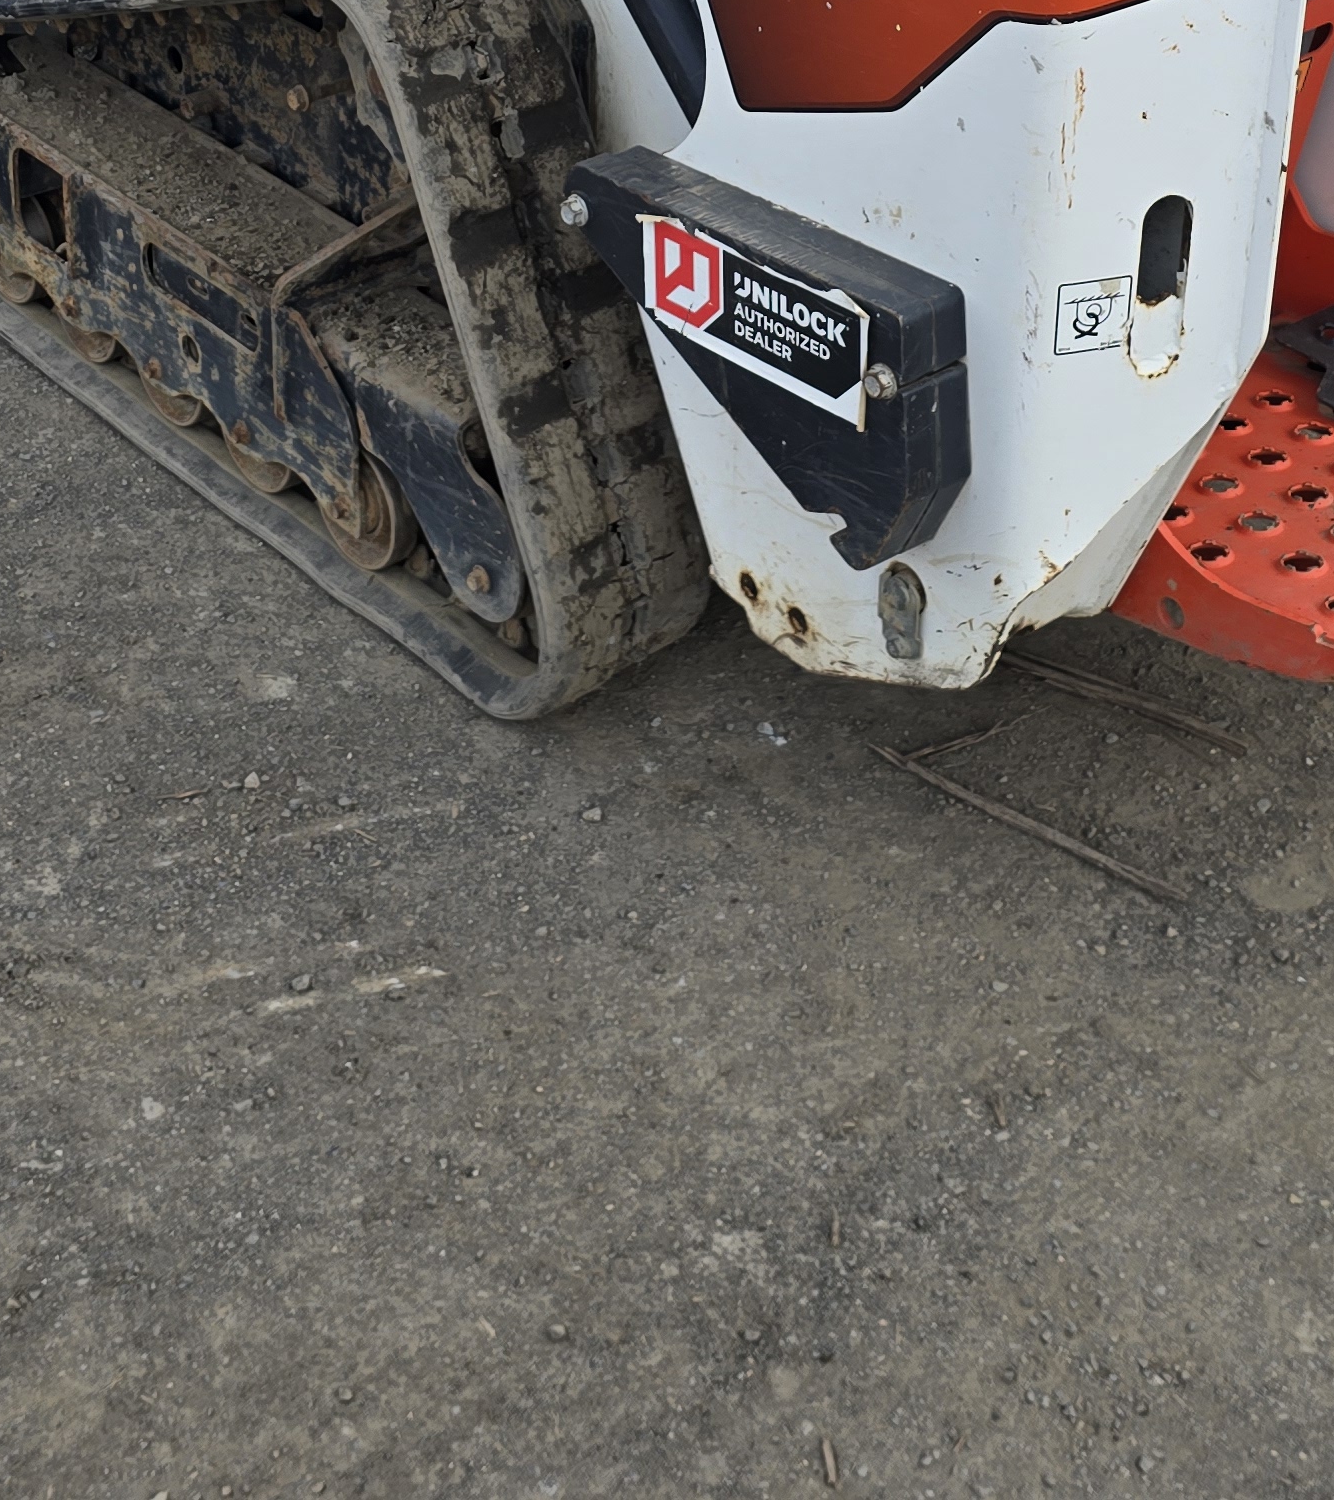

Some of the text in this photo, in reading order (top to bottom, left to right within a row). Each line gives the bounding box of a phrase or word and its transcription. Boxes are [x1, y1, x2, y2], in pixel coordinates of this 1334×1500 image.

[733, 271, 847, 348] UNILOCK
[733, 302, 831, 361] AUTHORIZED
[734, 320, 793, 362] DEALER
